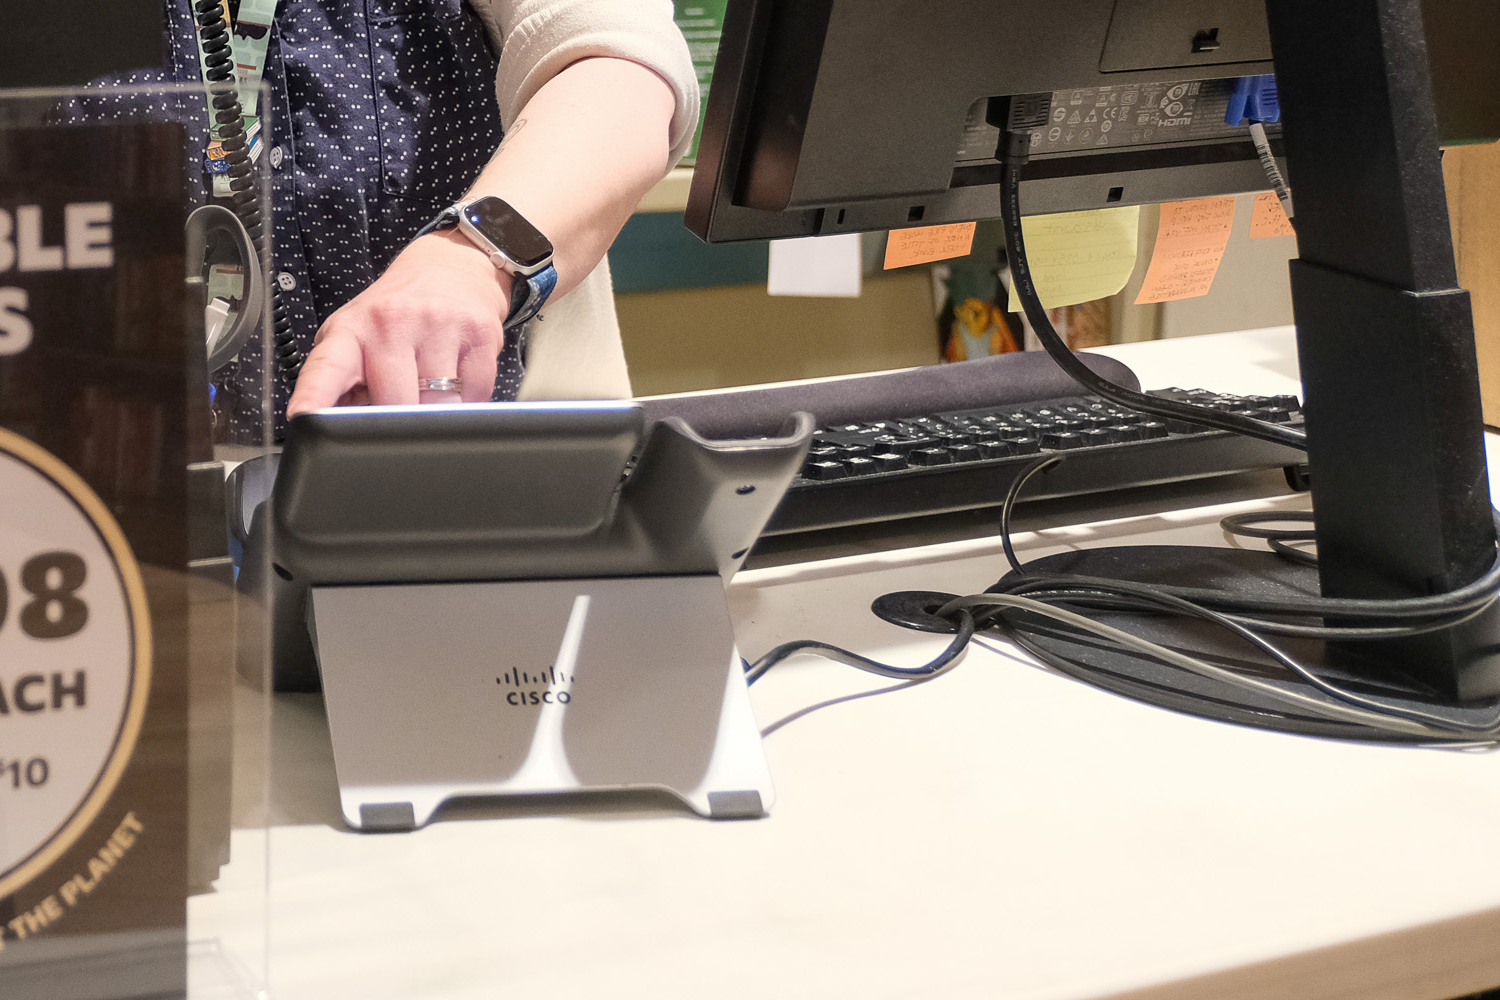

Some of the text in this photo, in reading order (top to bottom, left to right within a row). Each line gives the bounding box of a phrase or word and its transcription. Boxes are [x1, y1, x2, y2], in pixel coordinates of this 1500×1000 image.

[1158, 116, 1192, 128] HDMI
[7, 894, 65, 940] THE
[58, 809, 146, 907] PLANET
